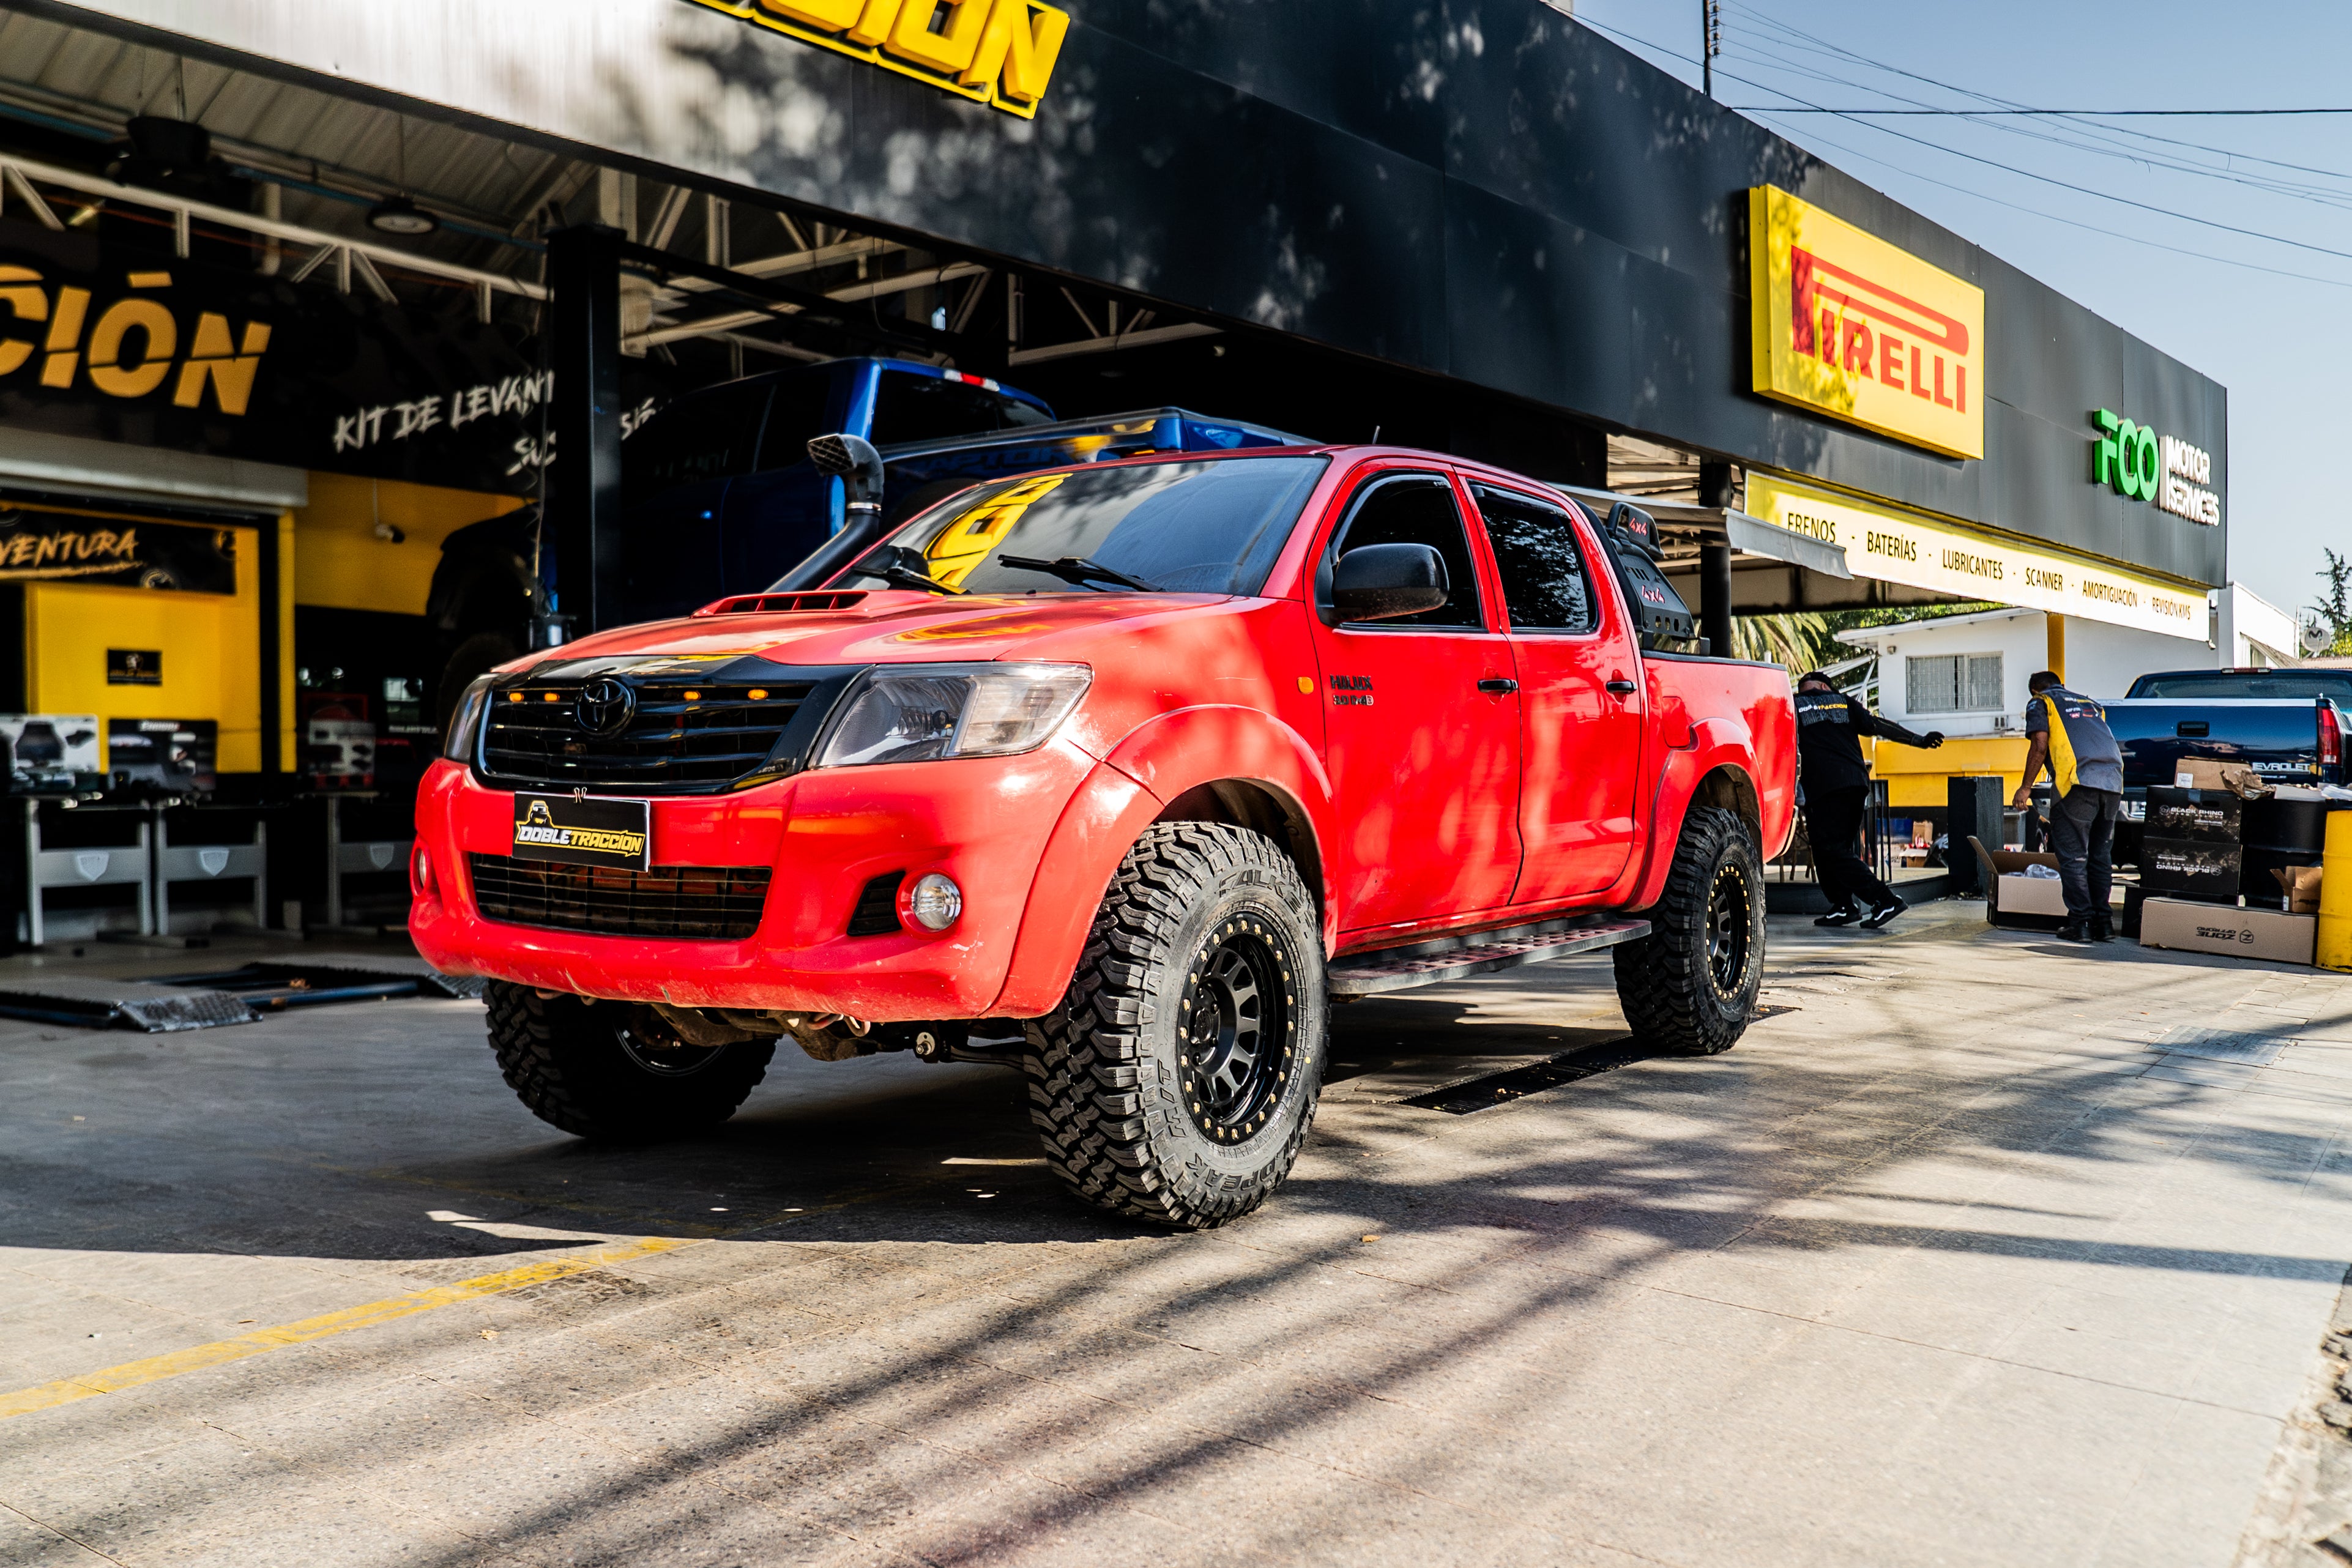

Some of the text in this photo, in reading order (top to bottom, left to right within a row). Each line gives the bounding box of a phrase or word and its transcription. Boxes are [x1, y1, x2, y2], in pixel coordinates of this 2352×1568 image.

[1792, 245, 1969, 414] PIRELLI
[332, 369, 556, 454] KIT DE LEVANT
[2093, 407, 2159, 502] FCO
[2167, 435, 2211, 485] MOTOR
[2169, 477, 2220, 526] SERVICES
[1867, 531, 1916, 562] BATERÍAS
[1943, 548, 2003, 580] LUBRICANTES
[2026, 567, 2063, 592] SCANNER
[2082, 580, 2138, 608] AMORTIGUACIÓN
[1330, 674, 1373, 691] HILUX
[2252, 762, 2311, 771] EVROLET
